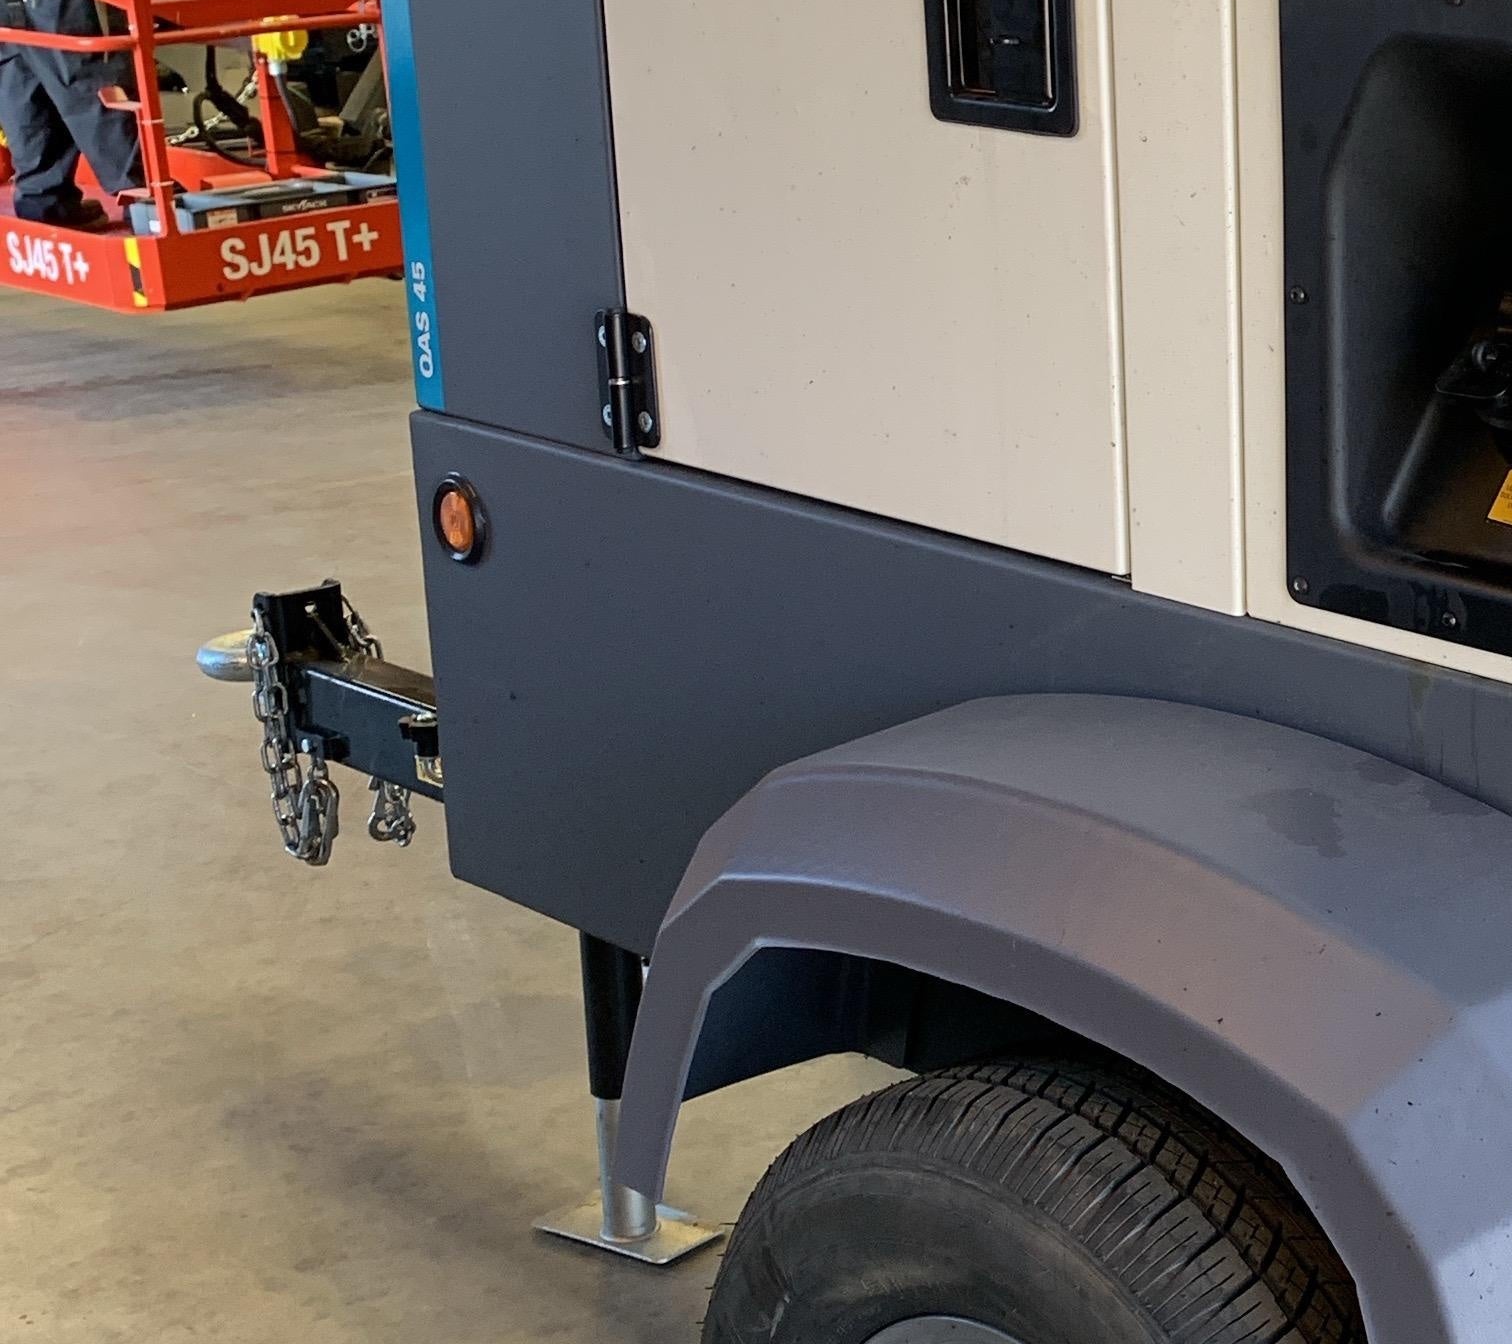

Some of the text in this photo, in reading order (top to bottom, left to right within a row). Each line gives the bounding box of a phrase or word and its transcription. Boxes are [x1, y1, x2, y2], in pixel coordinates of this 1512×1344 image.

[6, 230, 90, 285] SJ45 T+
[220, 219, 380, 281] SJ45 T+
[411, 261, 434, 378] QAS 45
